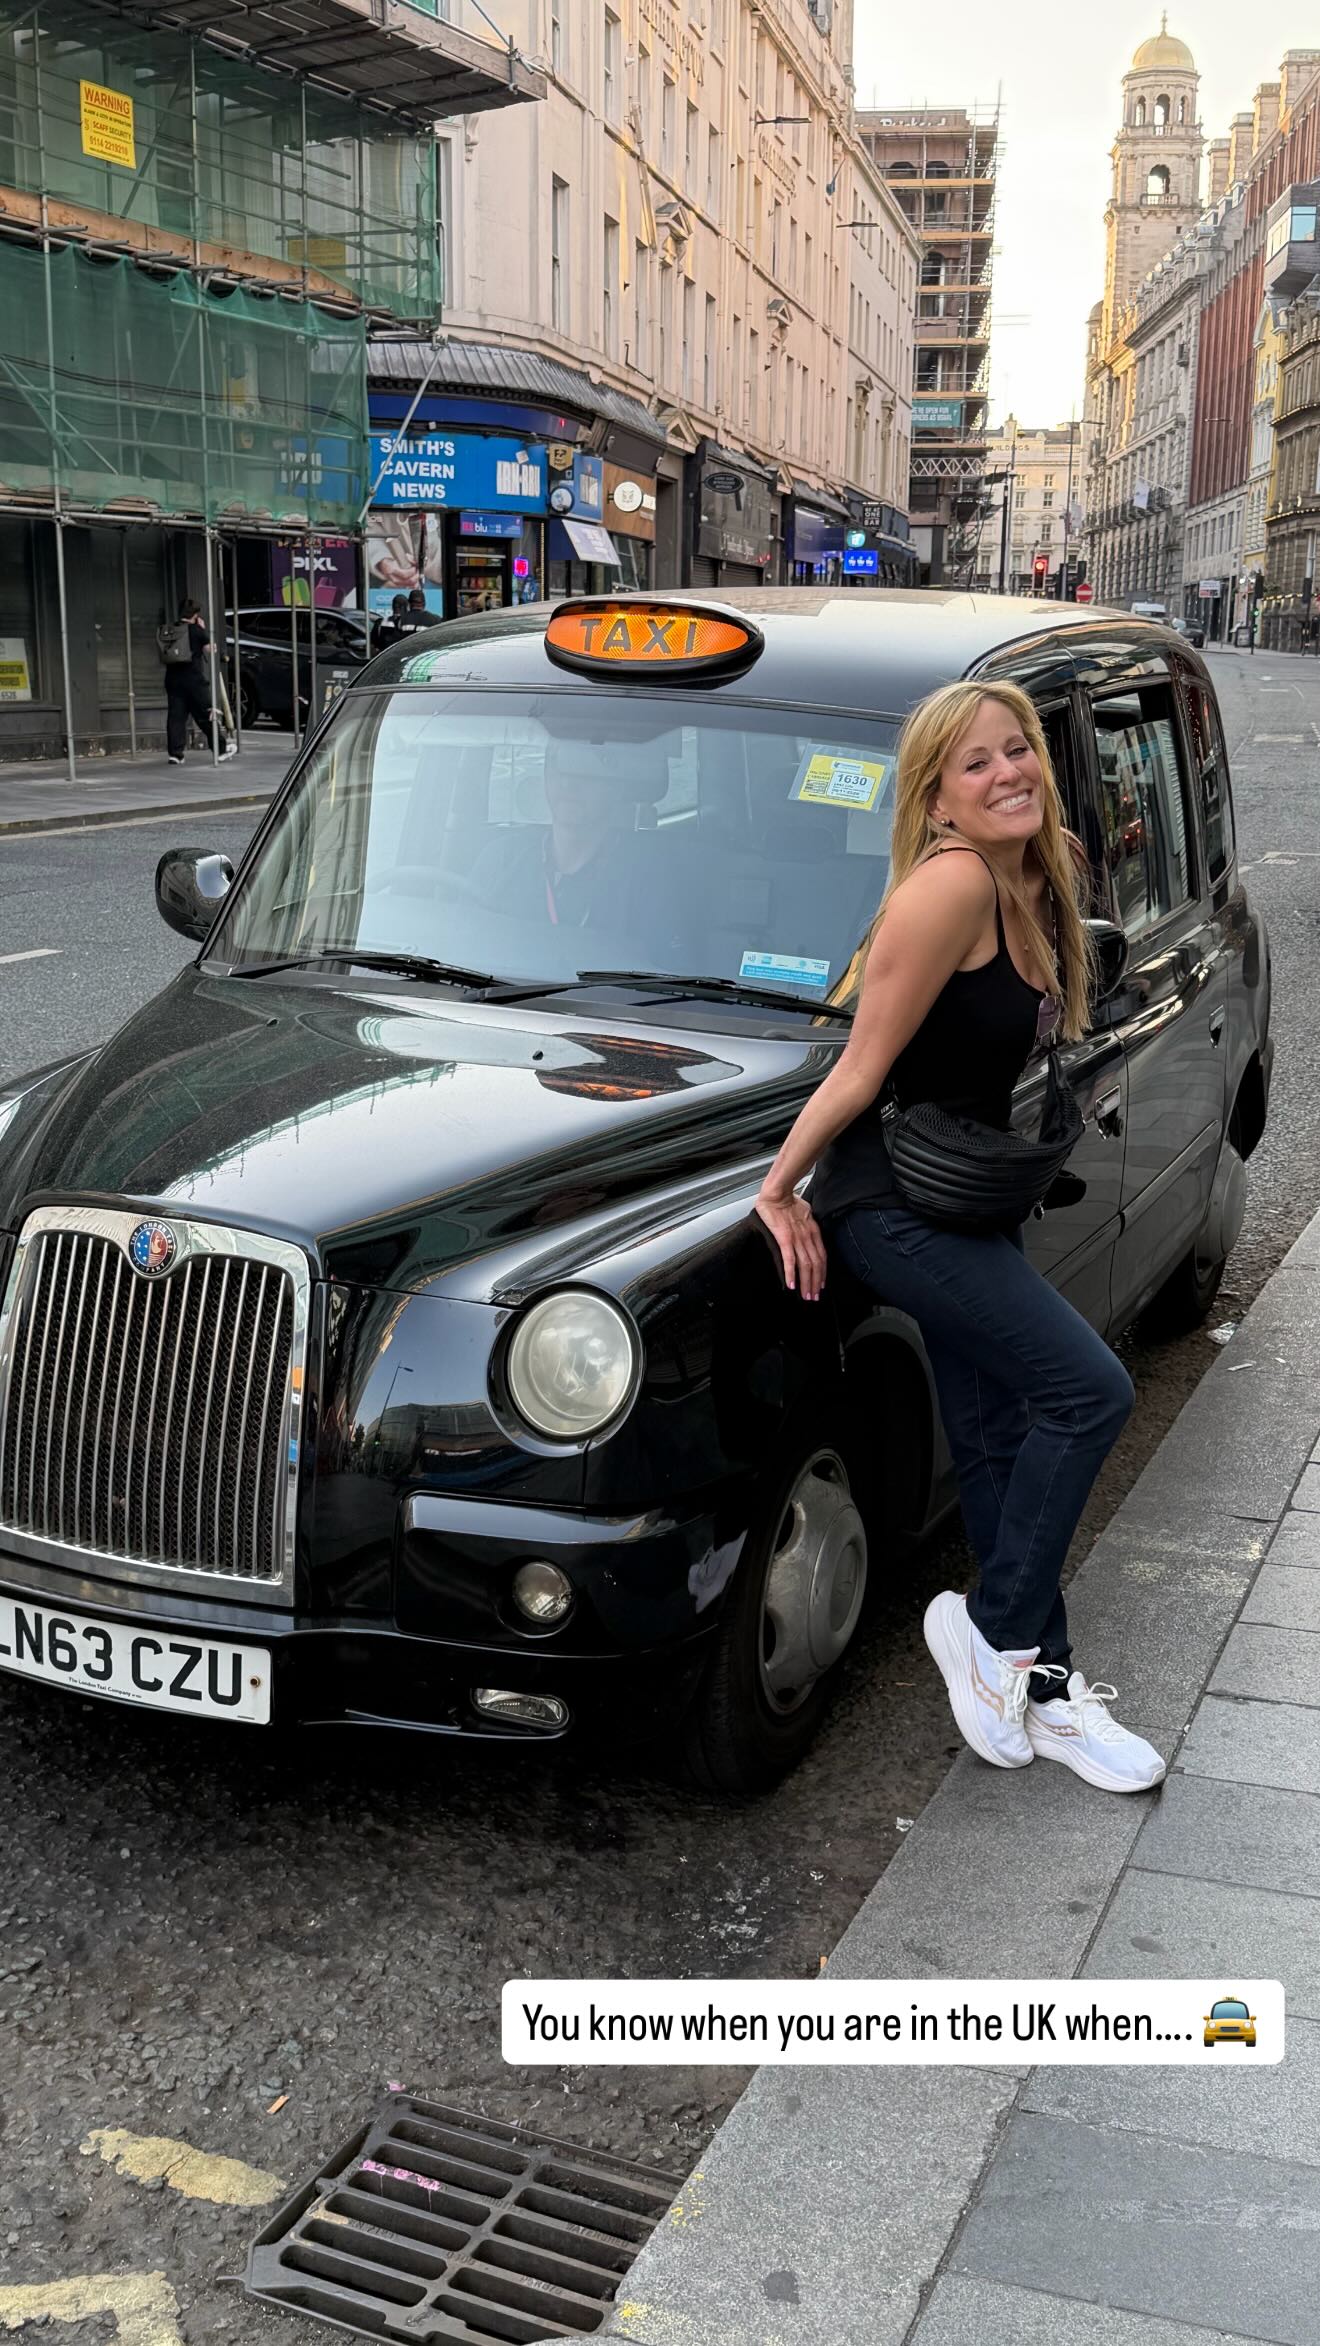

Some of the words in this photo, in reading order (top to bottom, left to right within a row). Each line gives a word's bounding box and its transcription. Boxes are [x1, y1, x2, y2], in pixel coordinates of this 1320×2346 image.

[84, 87, 130, 114] WARNING
[93, 121, 108, 131] SCAFF
[109, 127, 131, 140] SECURITY
[380, 438, 455, 457] SMITH'S
[381, 460, 455, 479] CAVERN
[393, 482, 446, 499] NEWS
[474, 522, 488, 532] blu
[293, 557, 338, 571] PIXL
[580, 618, 698, 655] TAXI
[837, 773, 868, 786] 1630
[131, 1636, 242, 1706] CZU
[79, 1679, 97, 1688] London
[108, 1687, 131, 1697] Company
